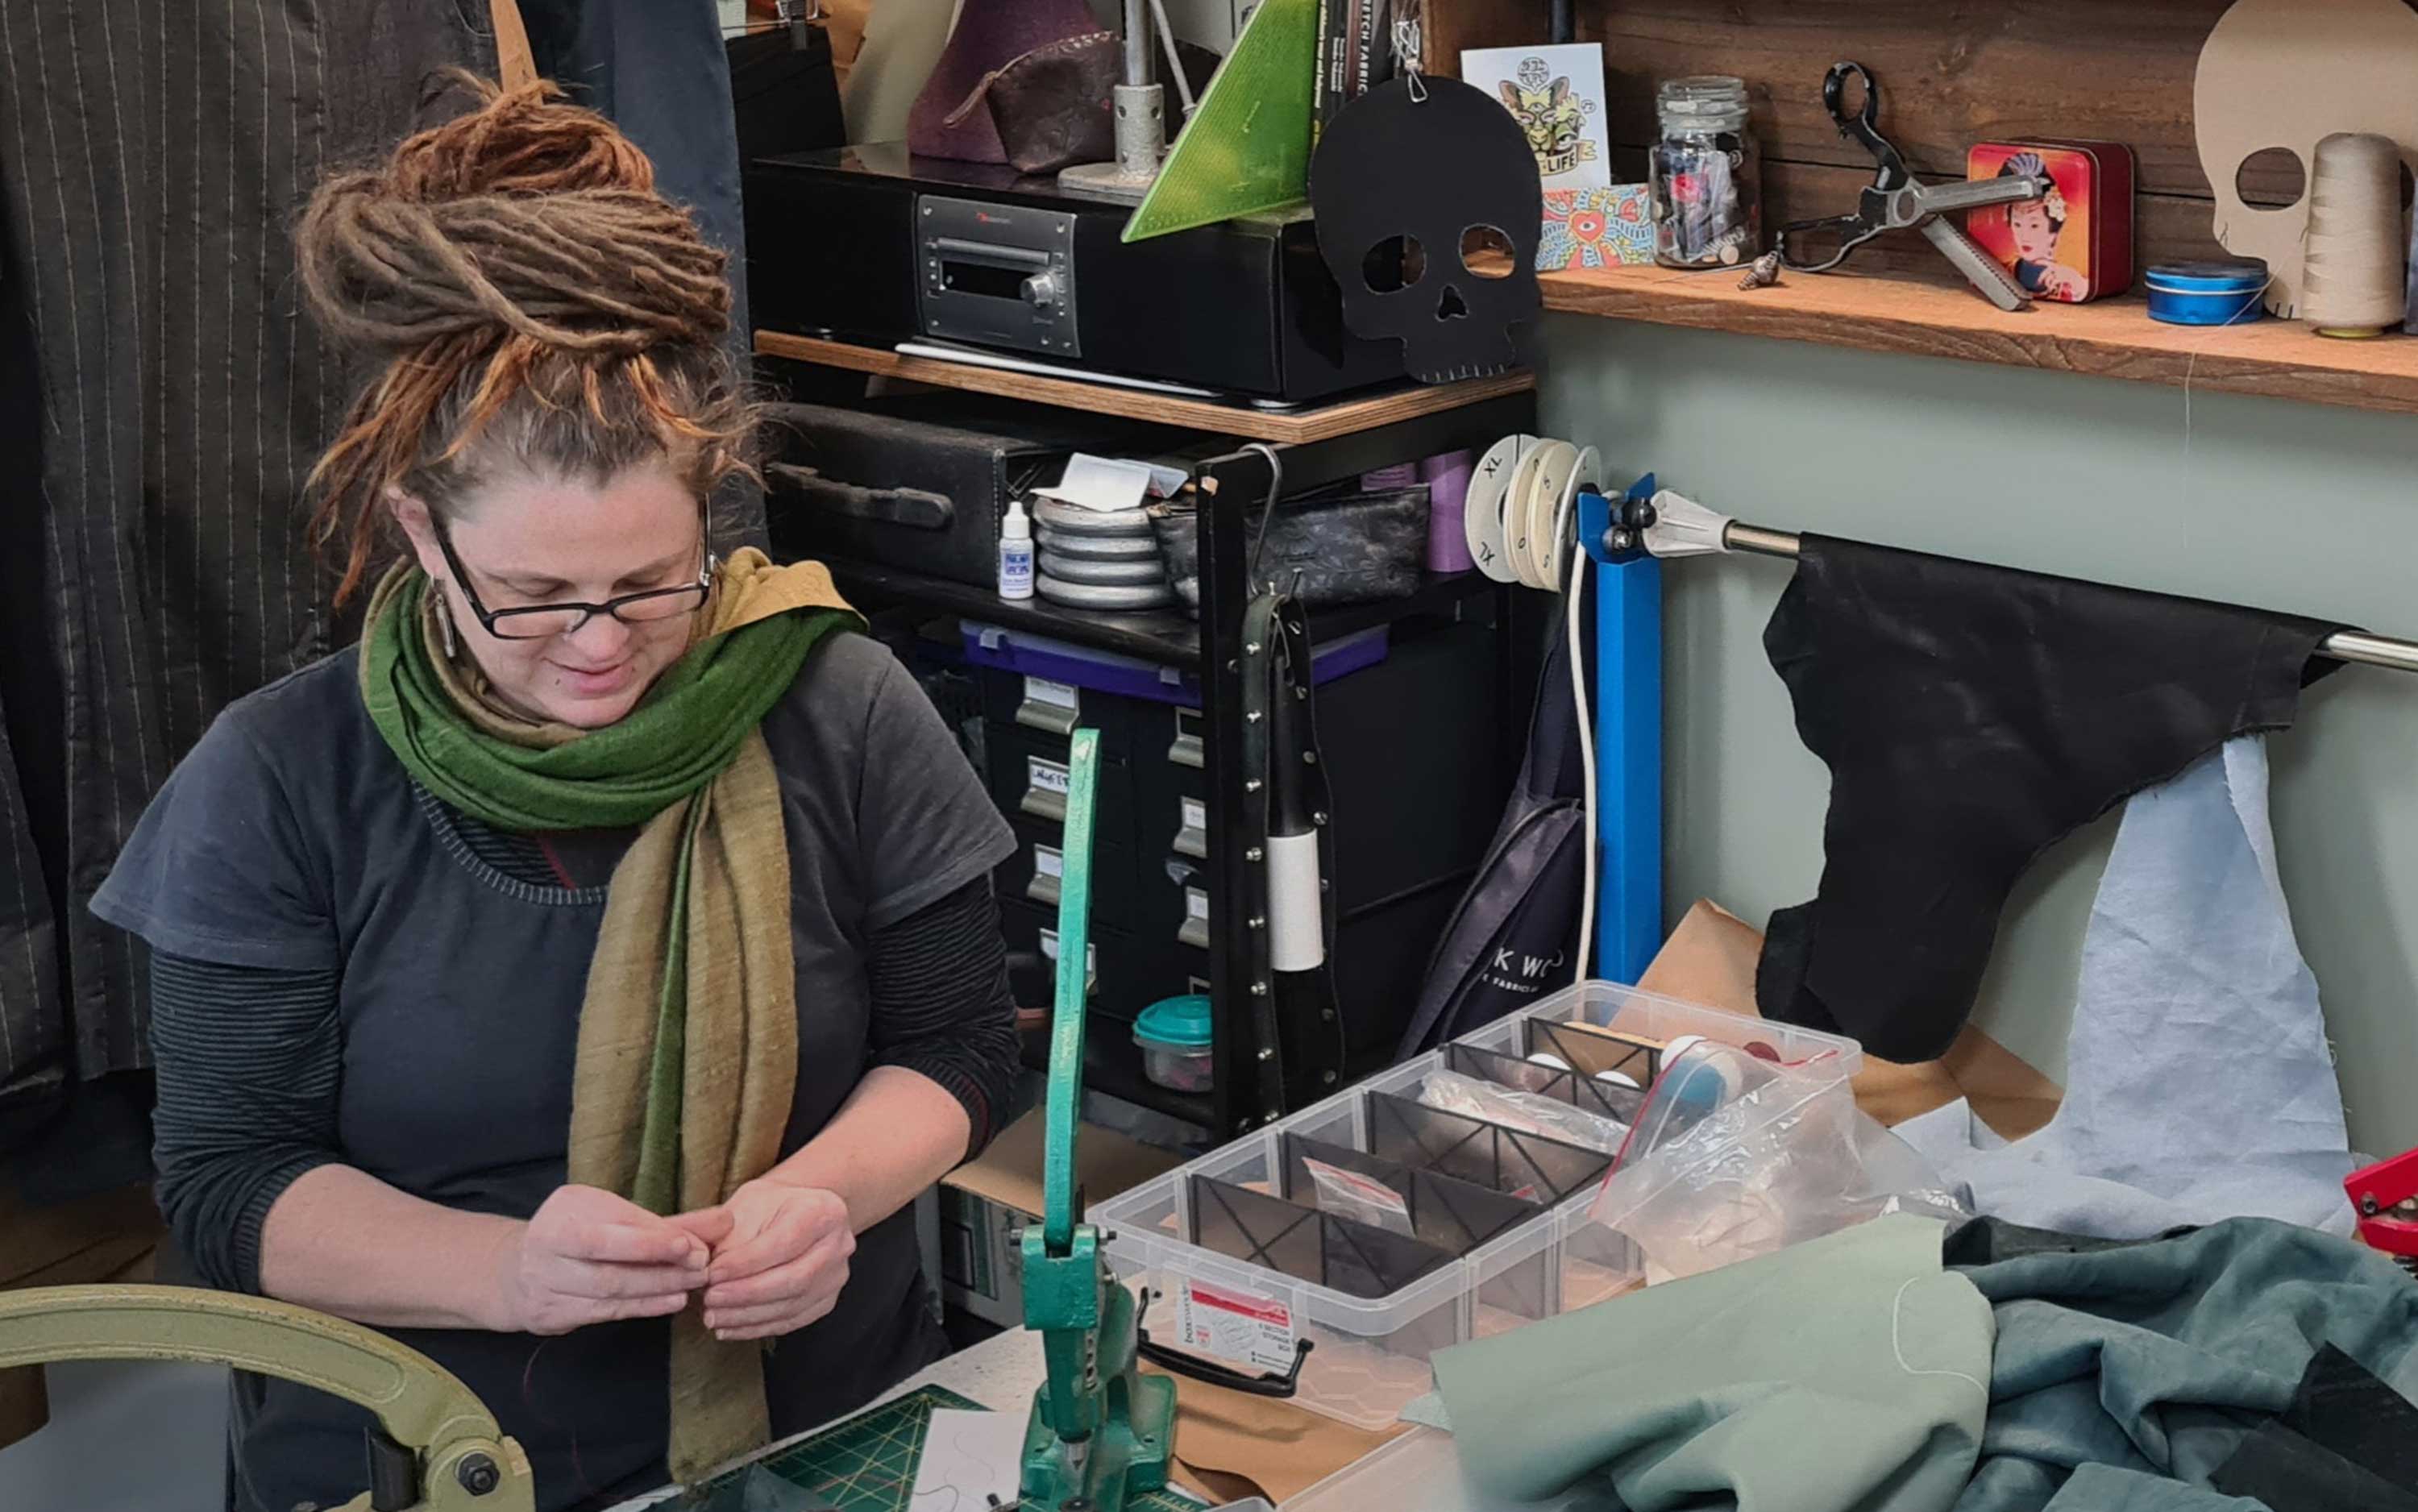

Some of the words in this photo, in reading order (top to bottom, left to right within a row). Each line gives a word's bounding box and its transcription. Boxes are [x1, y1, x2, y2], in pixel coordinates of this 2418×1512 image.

[1547, 153, 1576, 172] LIFE
[1484, 458, 1502, 479] XL
[1480, 542, 1495, 567] XL
